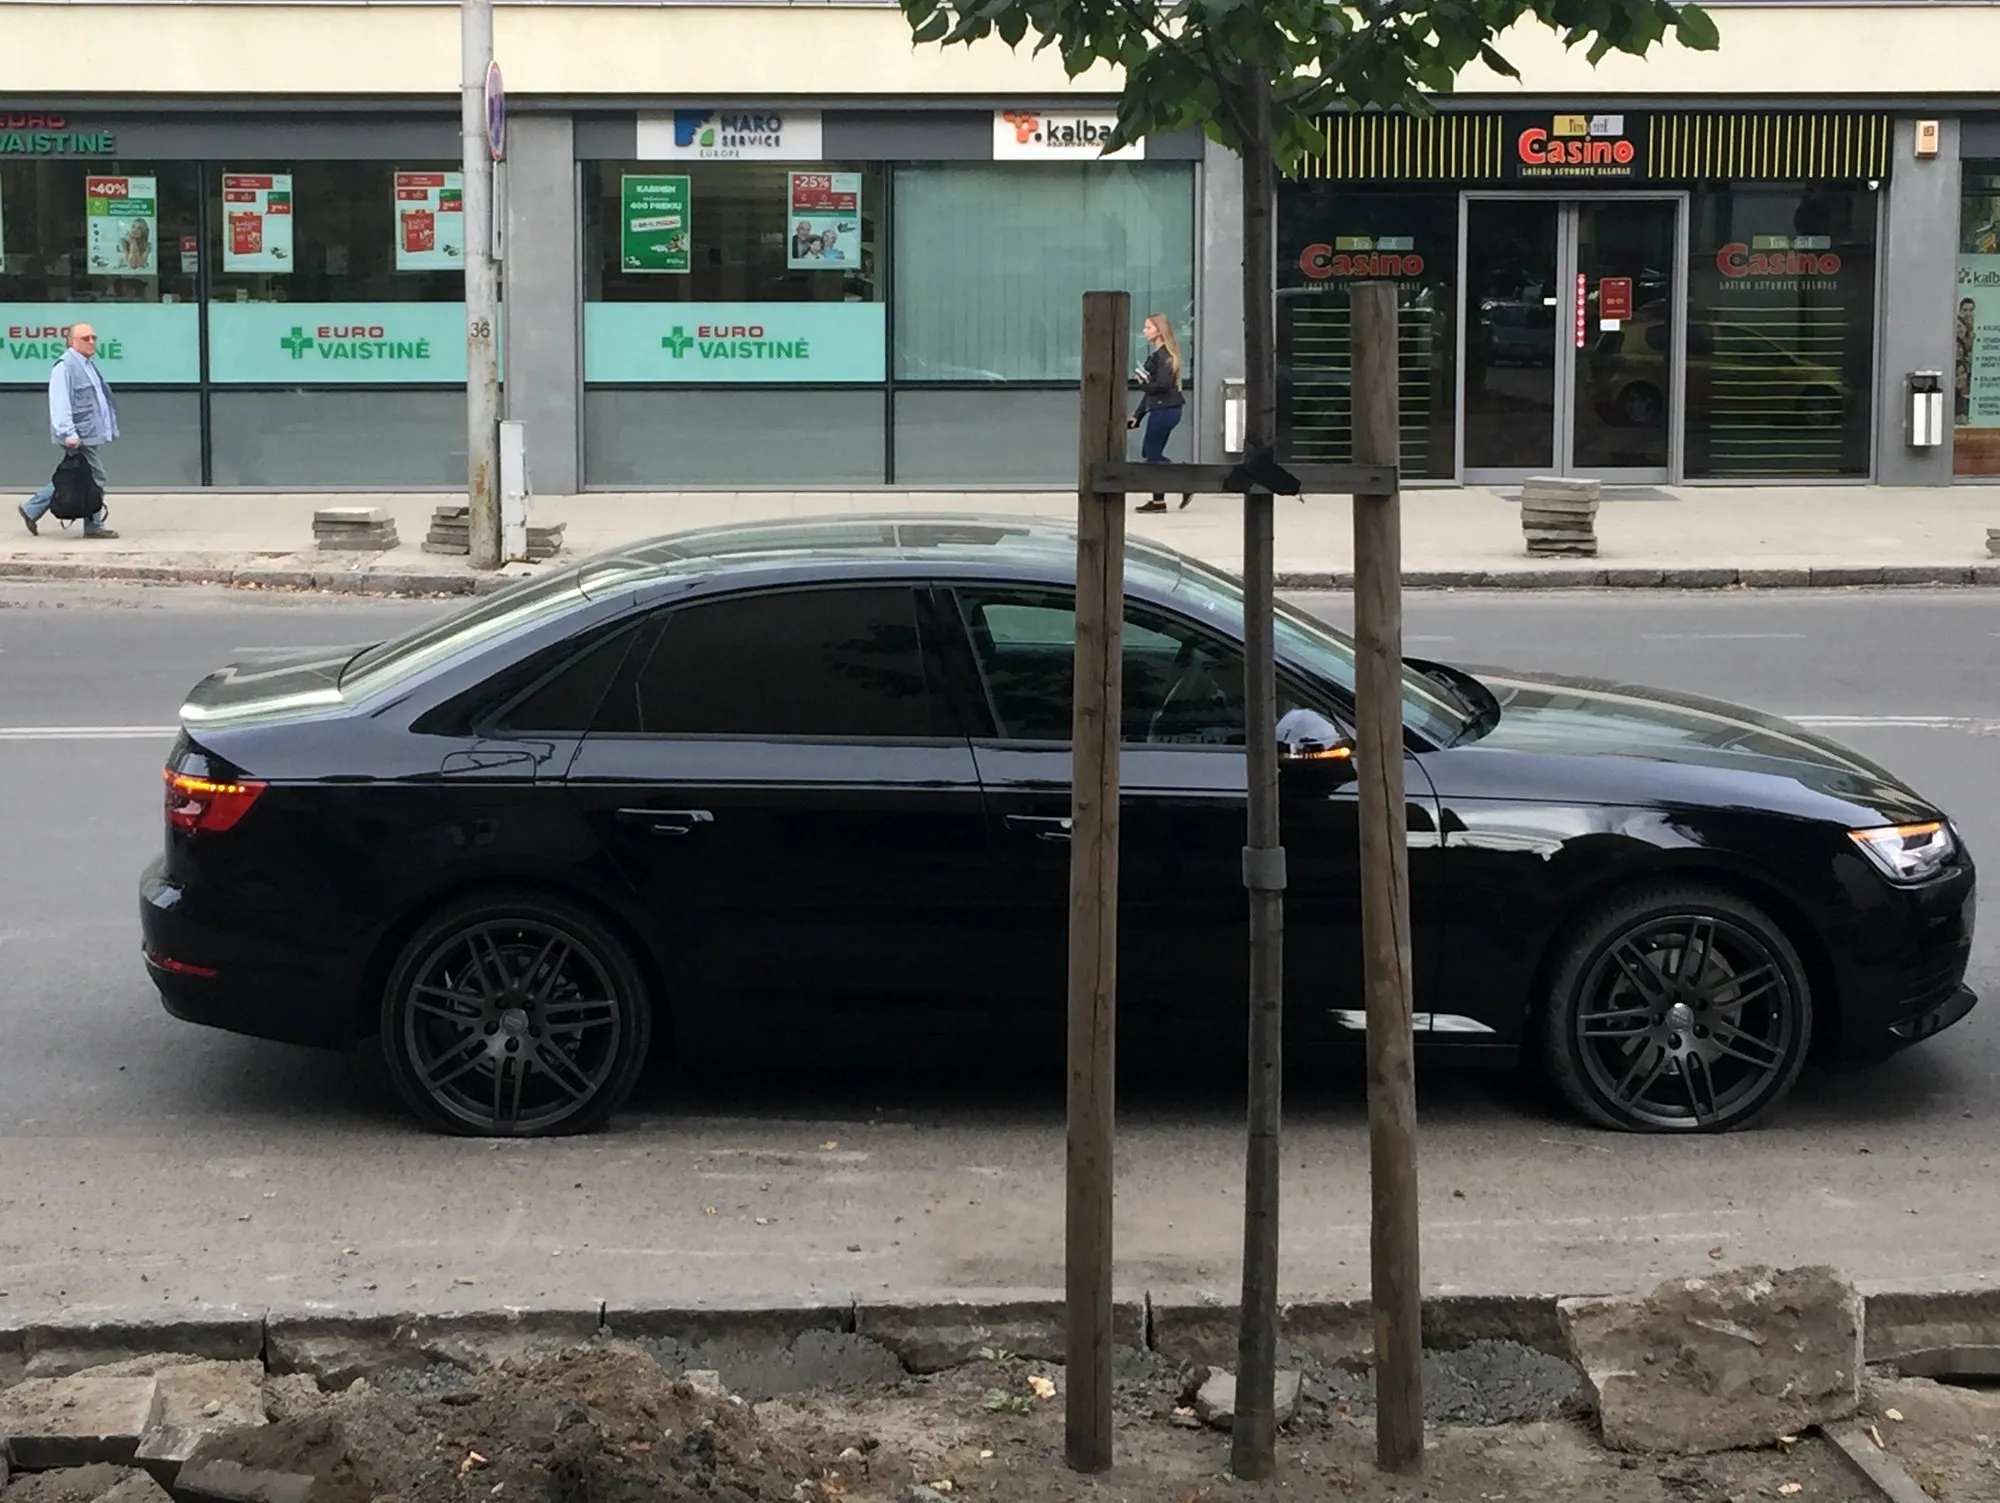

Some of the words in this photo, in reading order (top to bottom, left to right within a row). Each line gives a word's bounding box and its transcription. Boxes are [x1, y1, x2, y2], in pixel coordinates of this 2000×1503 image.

[721, 135, 781, 147] SERVICE
[1518, 127, 1634, 164] Casino
[795, 176, 830, 188] -25%
[1299, 243, 1424, 279] Casino
[1716, 242, 1841, 278] Casino
[317, 326, 384, 338] EURO
[470, 322, 491, 338] 36
[698, 326, 764, 338] EURO
[9, 338, 124, 360] VAISNĖ
[317, 338, 430, 359] VAISTINĖ
[698, 337, 810, 359] VAISTINĖ
